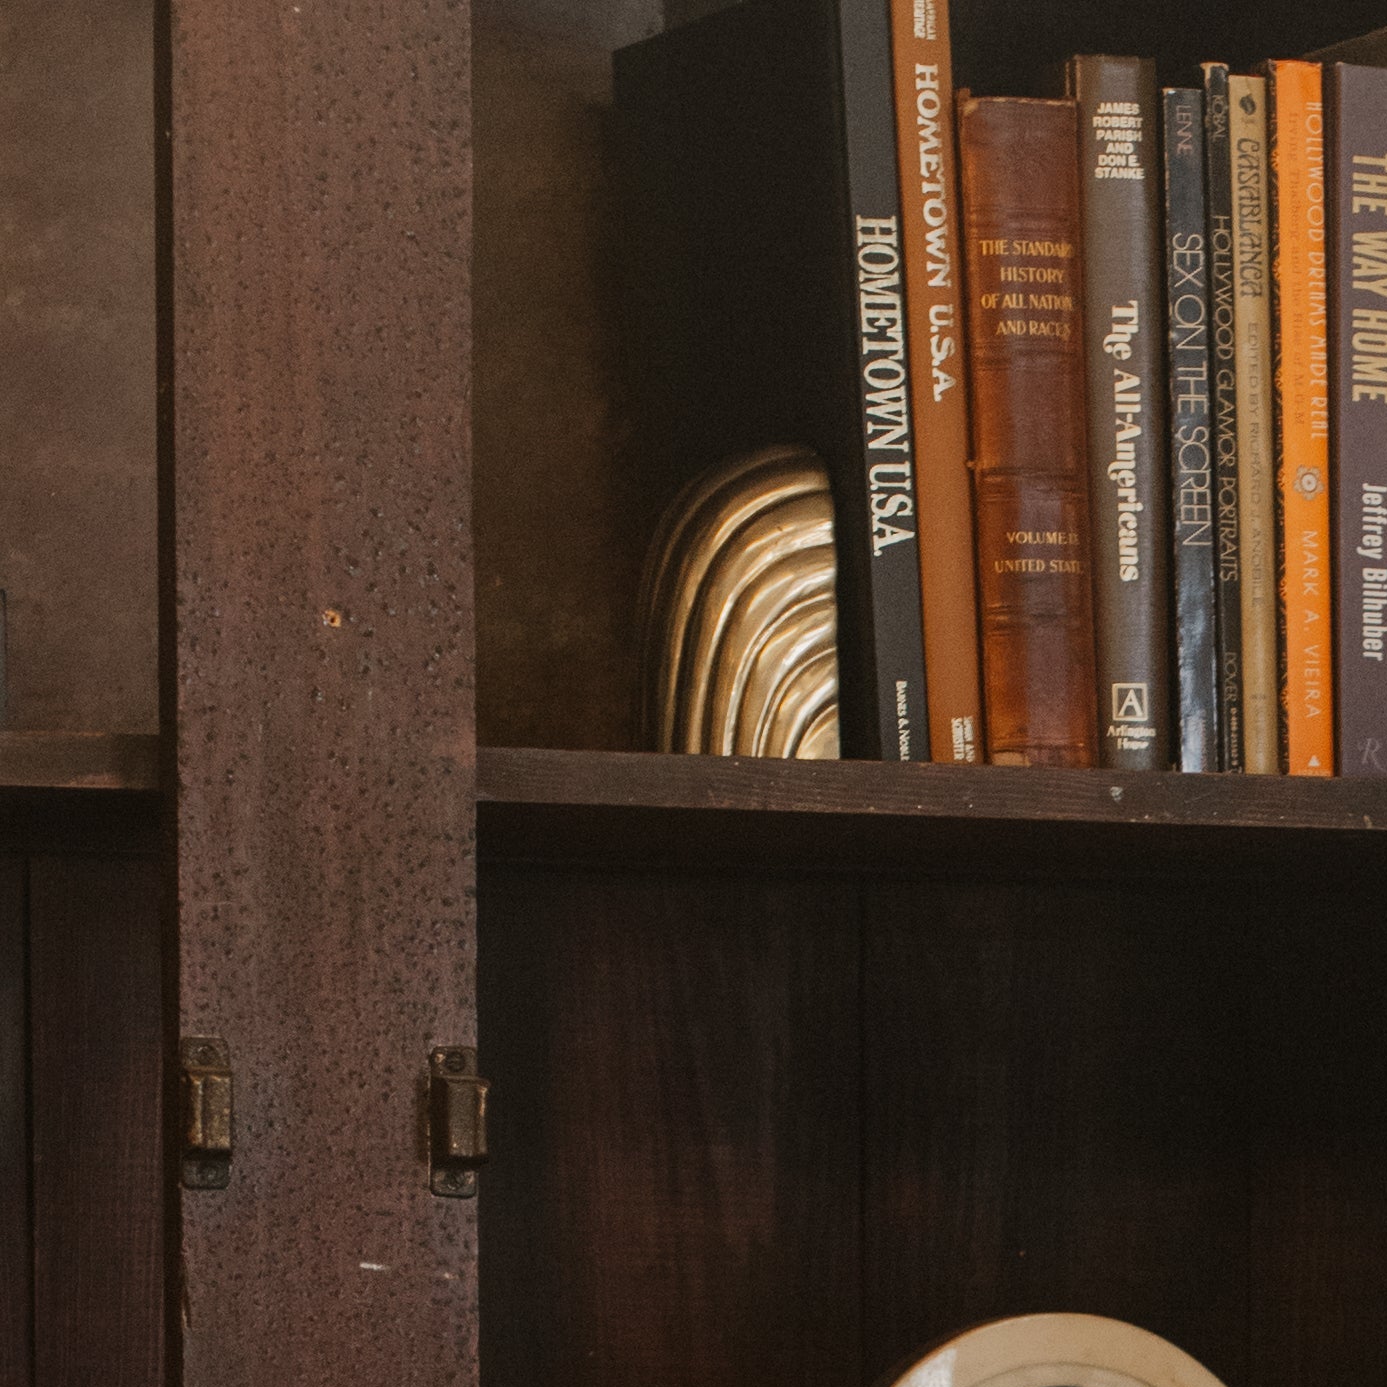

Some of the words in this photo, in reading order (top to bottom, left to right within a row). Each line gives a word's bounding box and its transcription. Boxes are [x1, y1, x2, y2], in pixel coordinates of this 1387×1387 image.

[1092, 116, 1143, 128] ROBERT
[1097, 102, 1140, 115] JAMES
[1212, 95, 1227, 141] KOBAL
[1096, 129, 1142, 142] PARISH
[1098, 154, 1126, 166] DON
[1106, 142, 1134, 154] AND
[915, 63, 952, 288] HOMETOWN
[1094, 167, 1145, 180] STANKE
[1305, 101, 1325, 243] HOLLYWOOD
[1236, 138, 1264, 298] CASABLANCA
[979, 240, 1009, 256] THE
[1172, 233, 1205, 288] SEX
[981, 293, 1000, 309] OF
[1001, 293, 1027, 309] ALL
[1000, 266, 1065, 284] HISTORY
[1212, 214, 1235, 360] HOLLYWOOD
[1307, 250, 1327, 328] DREAMS
[856, 215, 910, 452] HOMETOWN
[996, 320, 1027, 336] AND
[1103, 300, 1139, 360] The
[1174, 294, 1206, 350] ON
[929, 304, 956, 403] U.S.A.
[1246, 321, 1261, 388] EDITED
[1308, 335, 1328, 388] MADE
[1176, 361, 1208, 414] THE
[1248, 396, 1260, 416] BY
[1216, 369, 1237, 467] GLAMOR
[1310, 396, 1329, 440] REAL
[1107, 368, 1144, 582] All-Americans
[1177, 425, 1213, 546] SCREEN
[1249, 421, 1262, 507] RICHARD
[1006, 531, 1067, 545] VOLUME
[1218, 477, 1239, 581] PORTRAITS
[994, 559, 1046, 574] UNITED
[1302, 529, 1319, 595] MARK
[1303, 609, 1320, 632] A.
[1223, 652, 1238, 702] DOVER
[1304, 645, 1321, 719] VIEIRA
